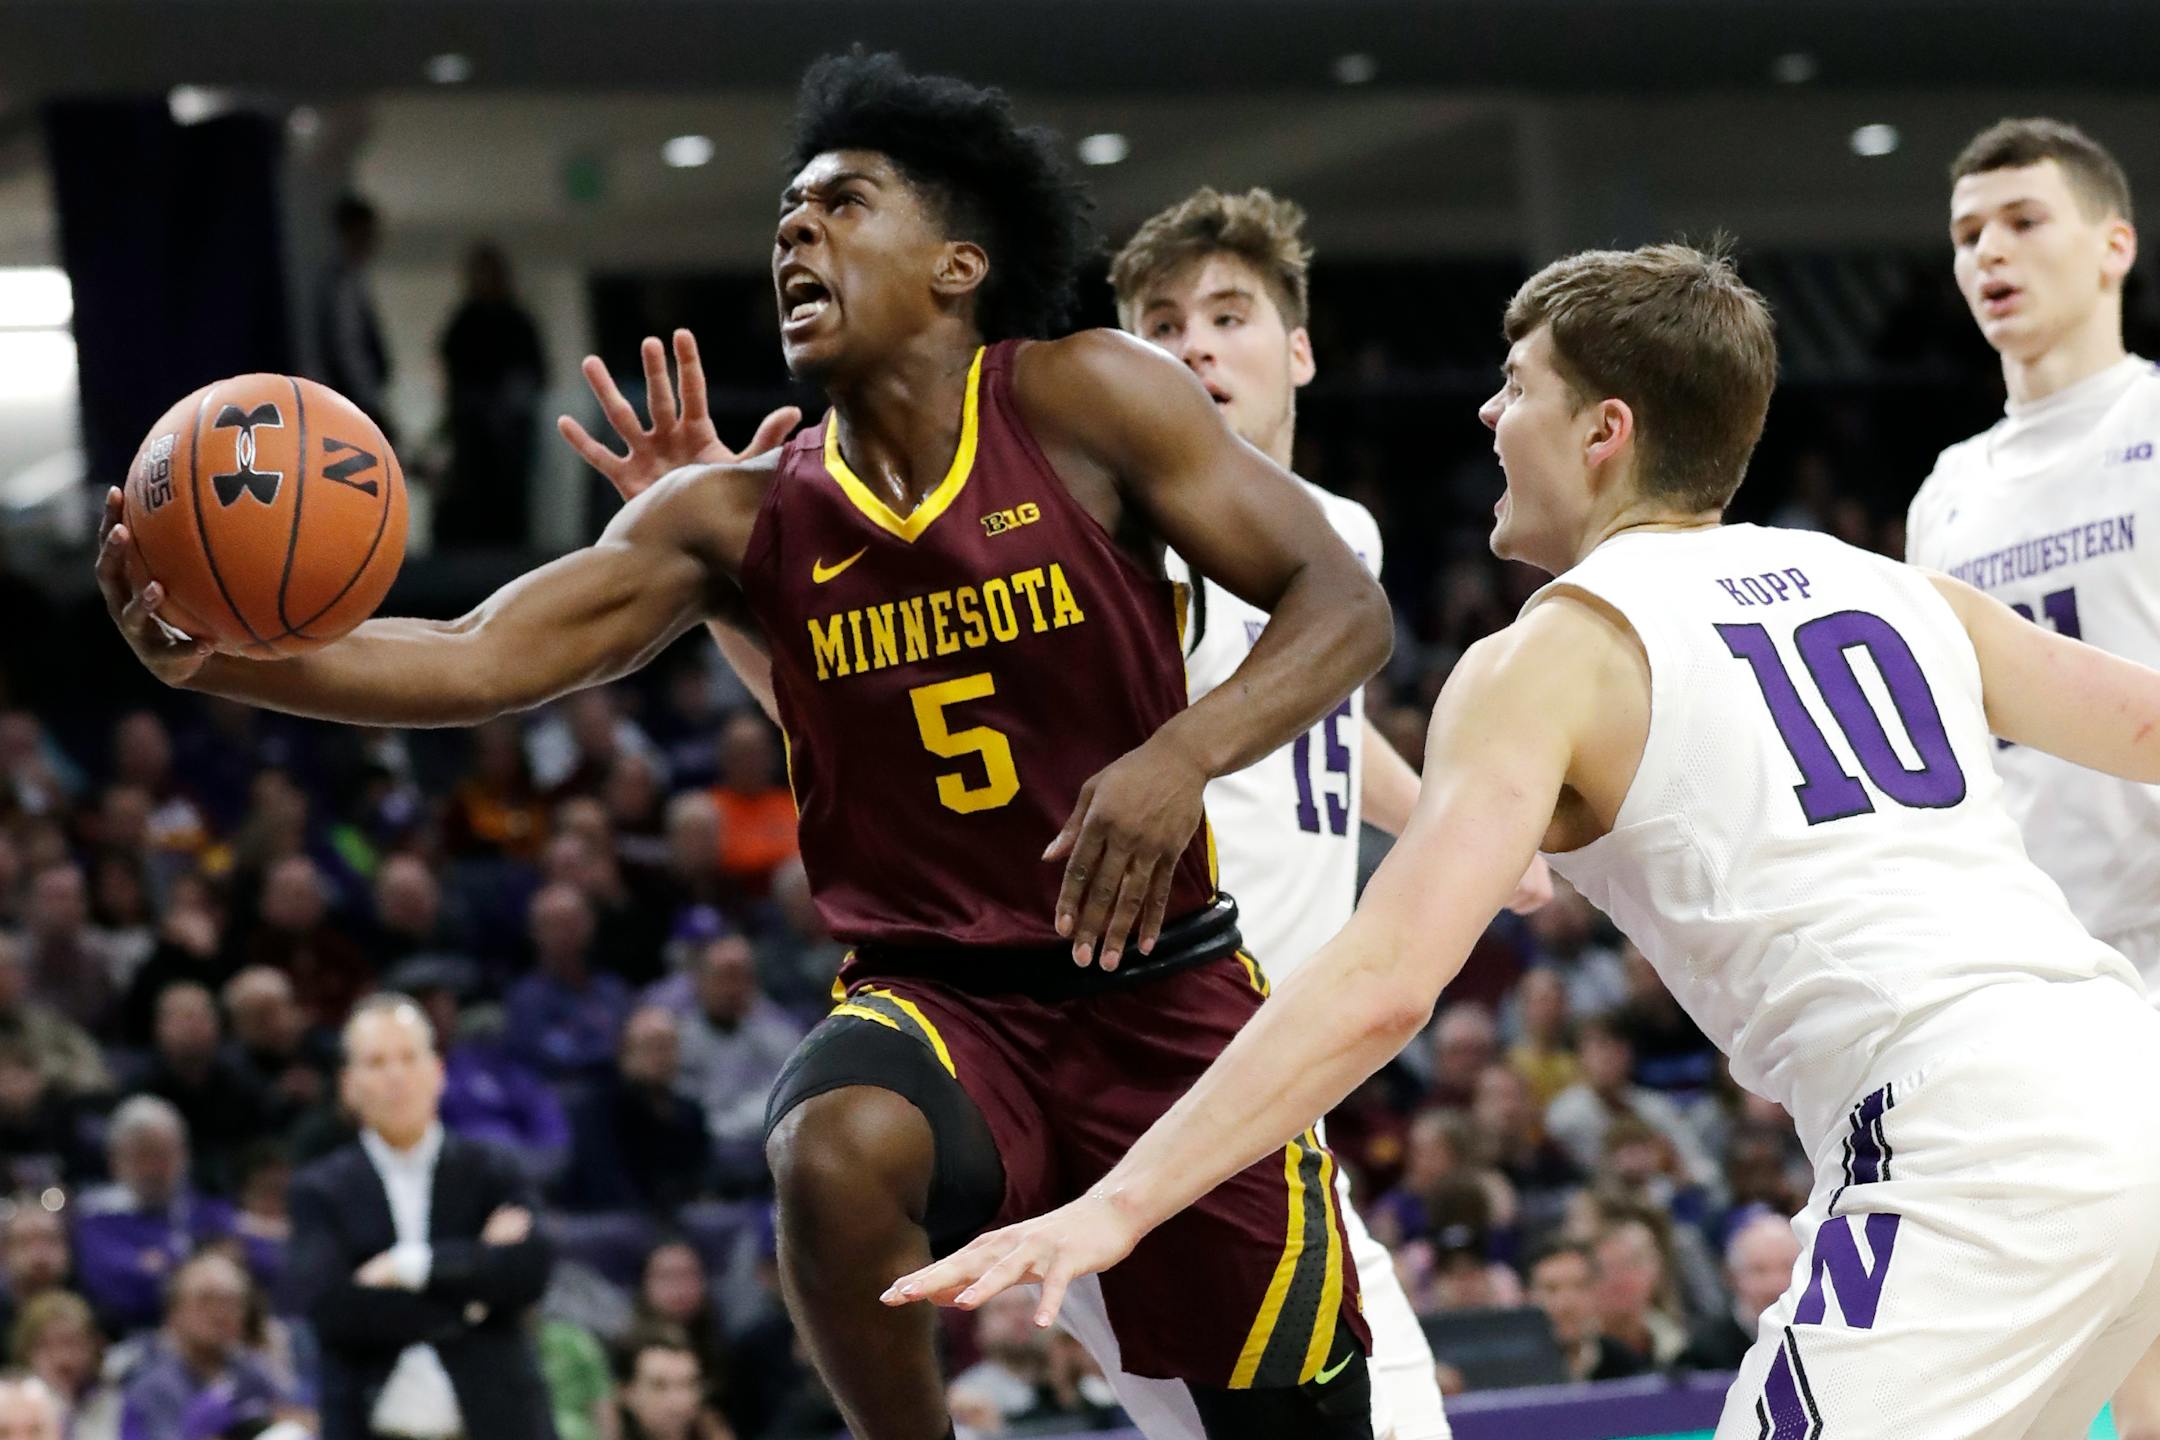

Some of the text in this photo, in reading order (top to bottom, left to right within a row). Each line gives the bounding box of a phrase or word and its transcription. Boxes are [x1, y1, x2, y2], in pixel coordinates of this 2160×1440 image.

[322, 437, 378, 498] N
[807, 563, 1085, 681] MINNESOTA
[1715, 567, 1812, 606] KOPP
[909, 672, 1020, 815] 5
[1293, 696, 1352, 837] 15
[1712, 609, 1966, 826] 10
[1792, 1212, 1902, 1330] N
